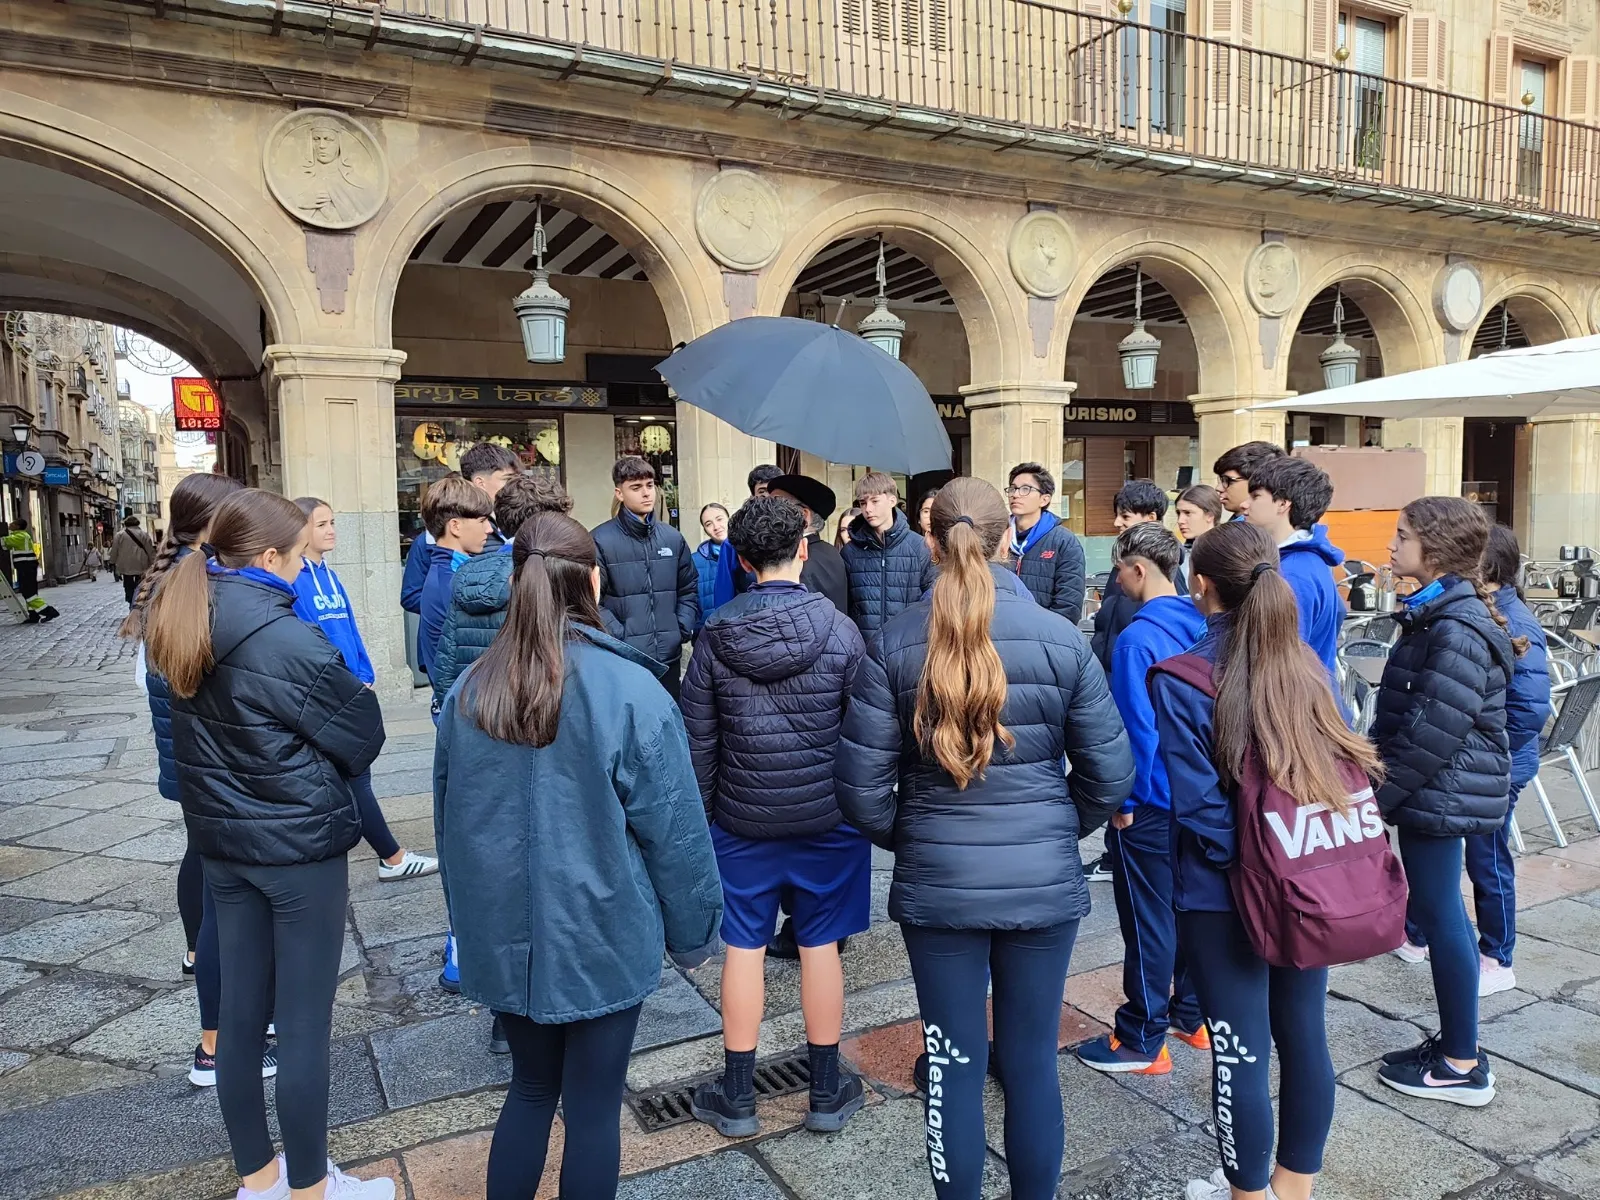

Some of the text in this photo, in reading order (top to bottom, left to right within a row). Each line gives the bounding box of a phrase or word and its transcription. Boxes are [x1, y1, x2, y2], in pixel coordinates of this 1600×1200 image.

[394, 384, 573, 404] arya tara
[935, 403, 1137, 421] NA URISMO
[1264, 788, 1384, 859] VANS
